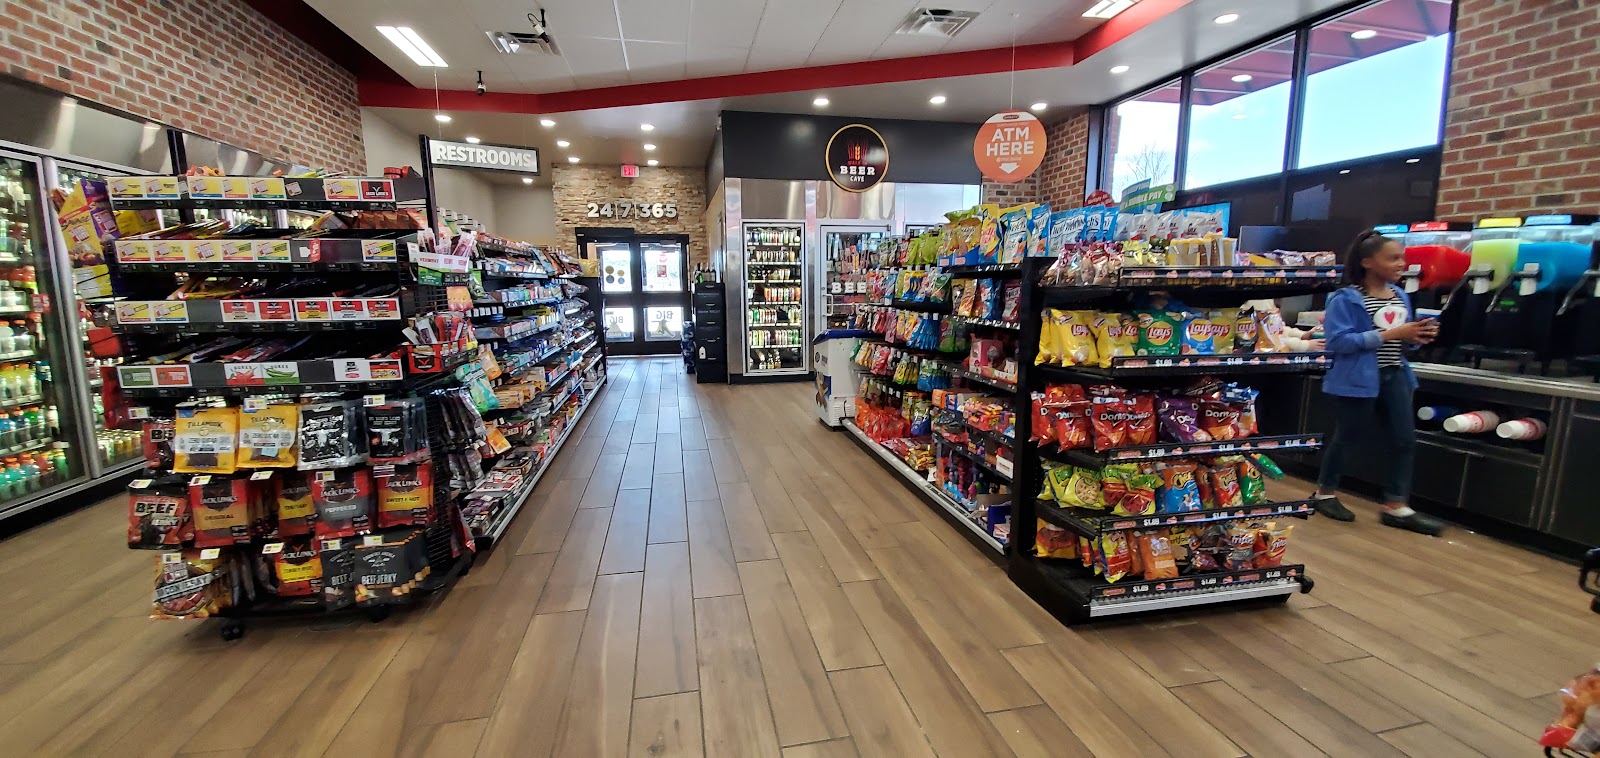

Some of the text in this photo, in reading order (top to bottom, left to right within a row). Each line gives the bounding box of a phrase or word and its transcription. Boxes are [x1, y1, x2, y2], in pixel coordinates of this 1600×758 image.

[992, 127, 1029, 142] ATM
[986, 141, 1034, 156] HERE
[436, 145, 532, 167] RESTROOMS
[623, 165, 637, 176] EXIT
[840, 165, 875, 175] BEER
[831, 282, 867, 293] BEE
[1205, 409, 1239, 419] Doritos
[135, 502, 176, 514] BEEF
[361, 573, 398, 585] BEEF JERKY
